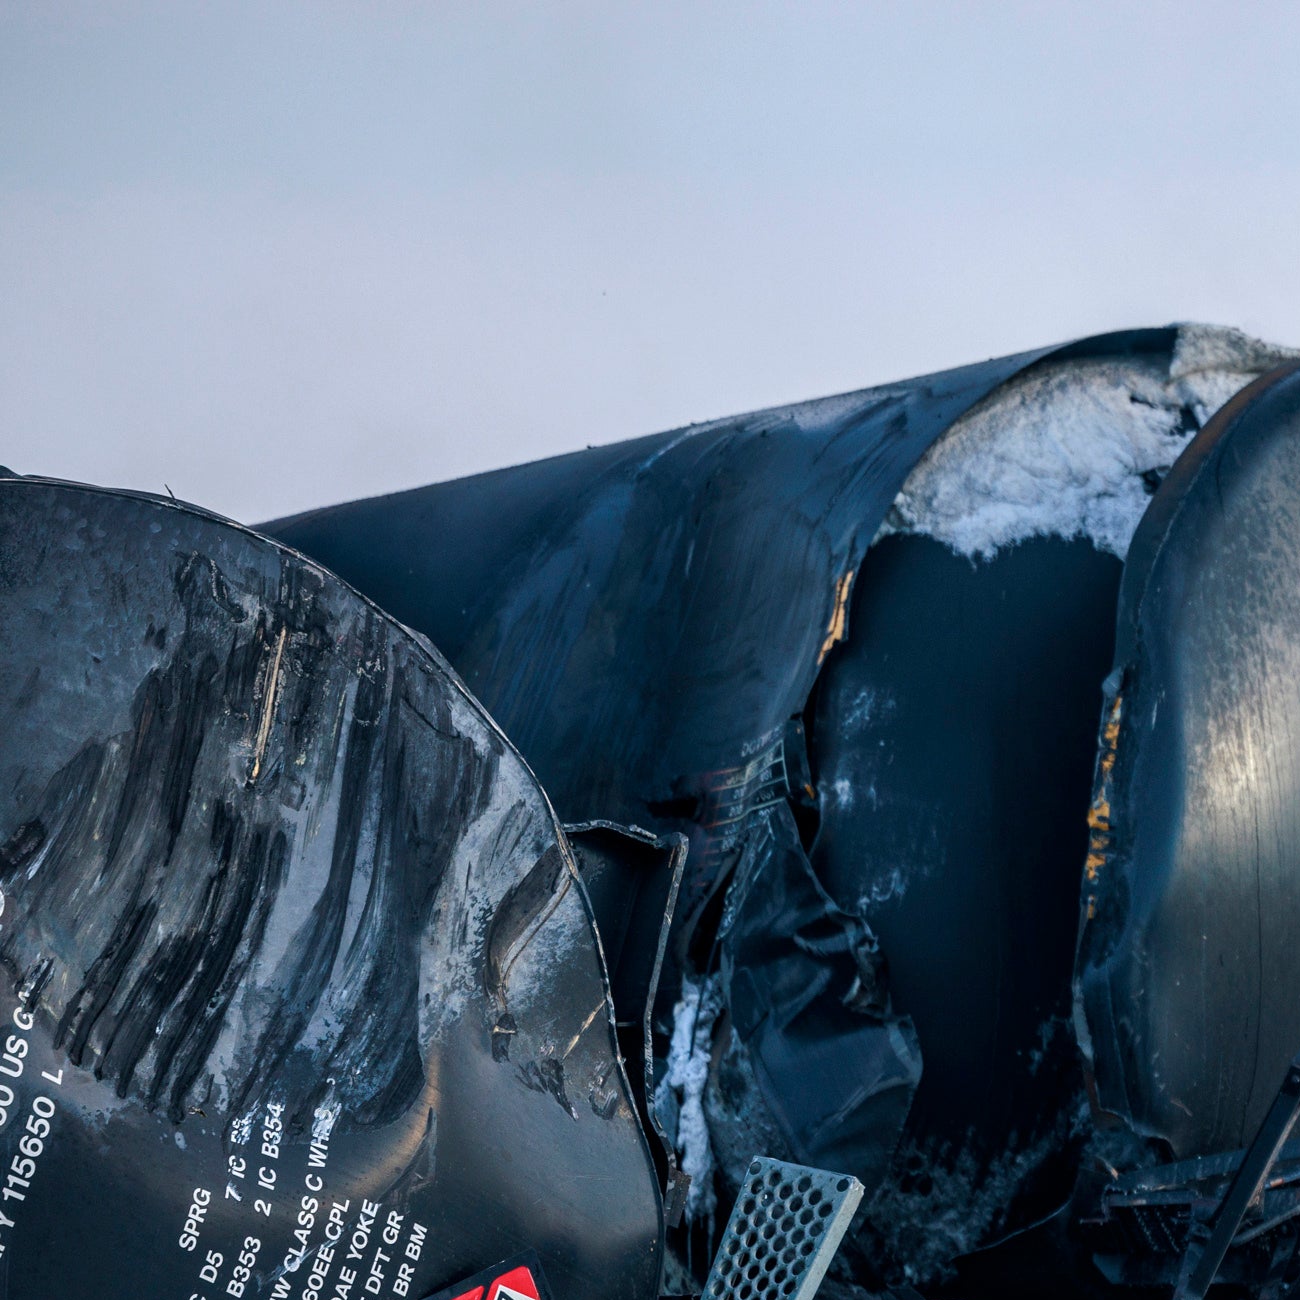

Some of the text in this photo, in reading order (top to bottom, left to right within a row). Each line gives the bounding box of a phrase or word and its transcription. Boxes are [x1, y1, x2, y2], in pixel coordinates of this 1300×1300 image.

[0, 1034, 29, 1078] US
[2, 1096, 57, 1202] 115650
[41, 1068, 64, 1086] L
[261, 1103, 287, 1159] B354
[224, 1183, 243, 1202] 7
[228, 1155, 247, 1179] IC
[258, 1166, 277, 1190] IC
[178, 1187, 212, 1251] SPRG
[254, 1199, 272, 1217] 2
[283, 1194, 319, 1273] CLASS
[304, 1173, 324, 1192] C
[324, 1198, 351, 1241] CPL
[346, 1198, 380, 1260] YOKE
[199, 1250, 224, 1284] D5
[225, 1236, 262, 1298] B353
[364, 1247, 391, 1295] DFT
[382, 1209, 405, 1246] GR
[392, 1262, 416, 1298] BR
[404, 1222, 428, 1262] BM
